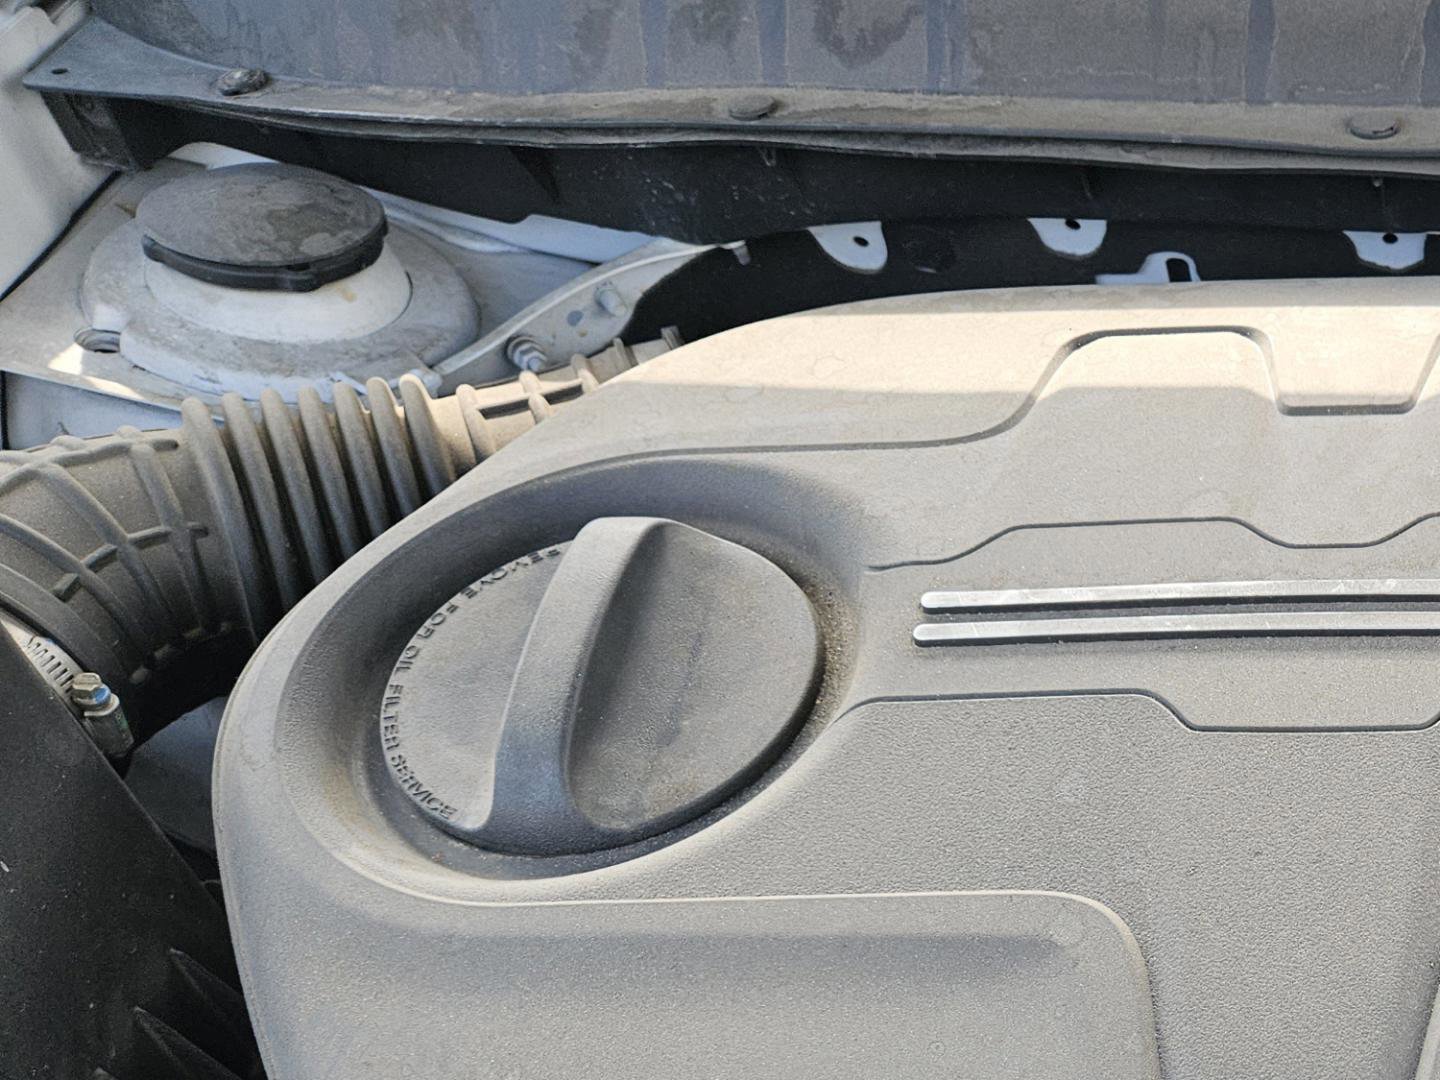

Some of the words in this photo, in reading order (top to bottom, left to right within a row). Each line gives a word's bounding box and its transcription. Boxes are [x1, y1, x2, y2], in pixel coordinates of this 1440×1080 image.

[417, 602, 460, 639] FOR
[394, 645, 421, 677] OIL
[382, 684, 405, 751] FILTER
[390, 754, 459, 820] SERVICE
